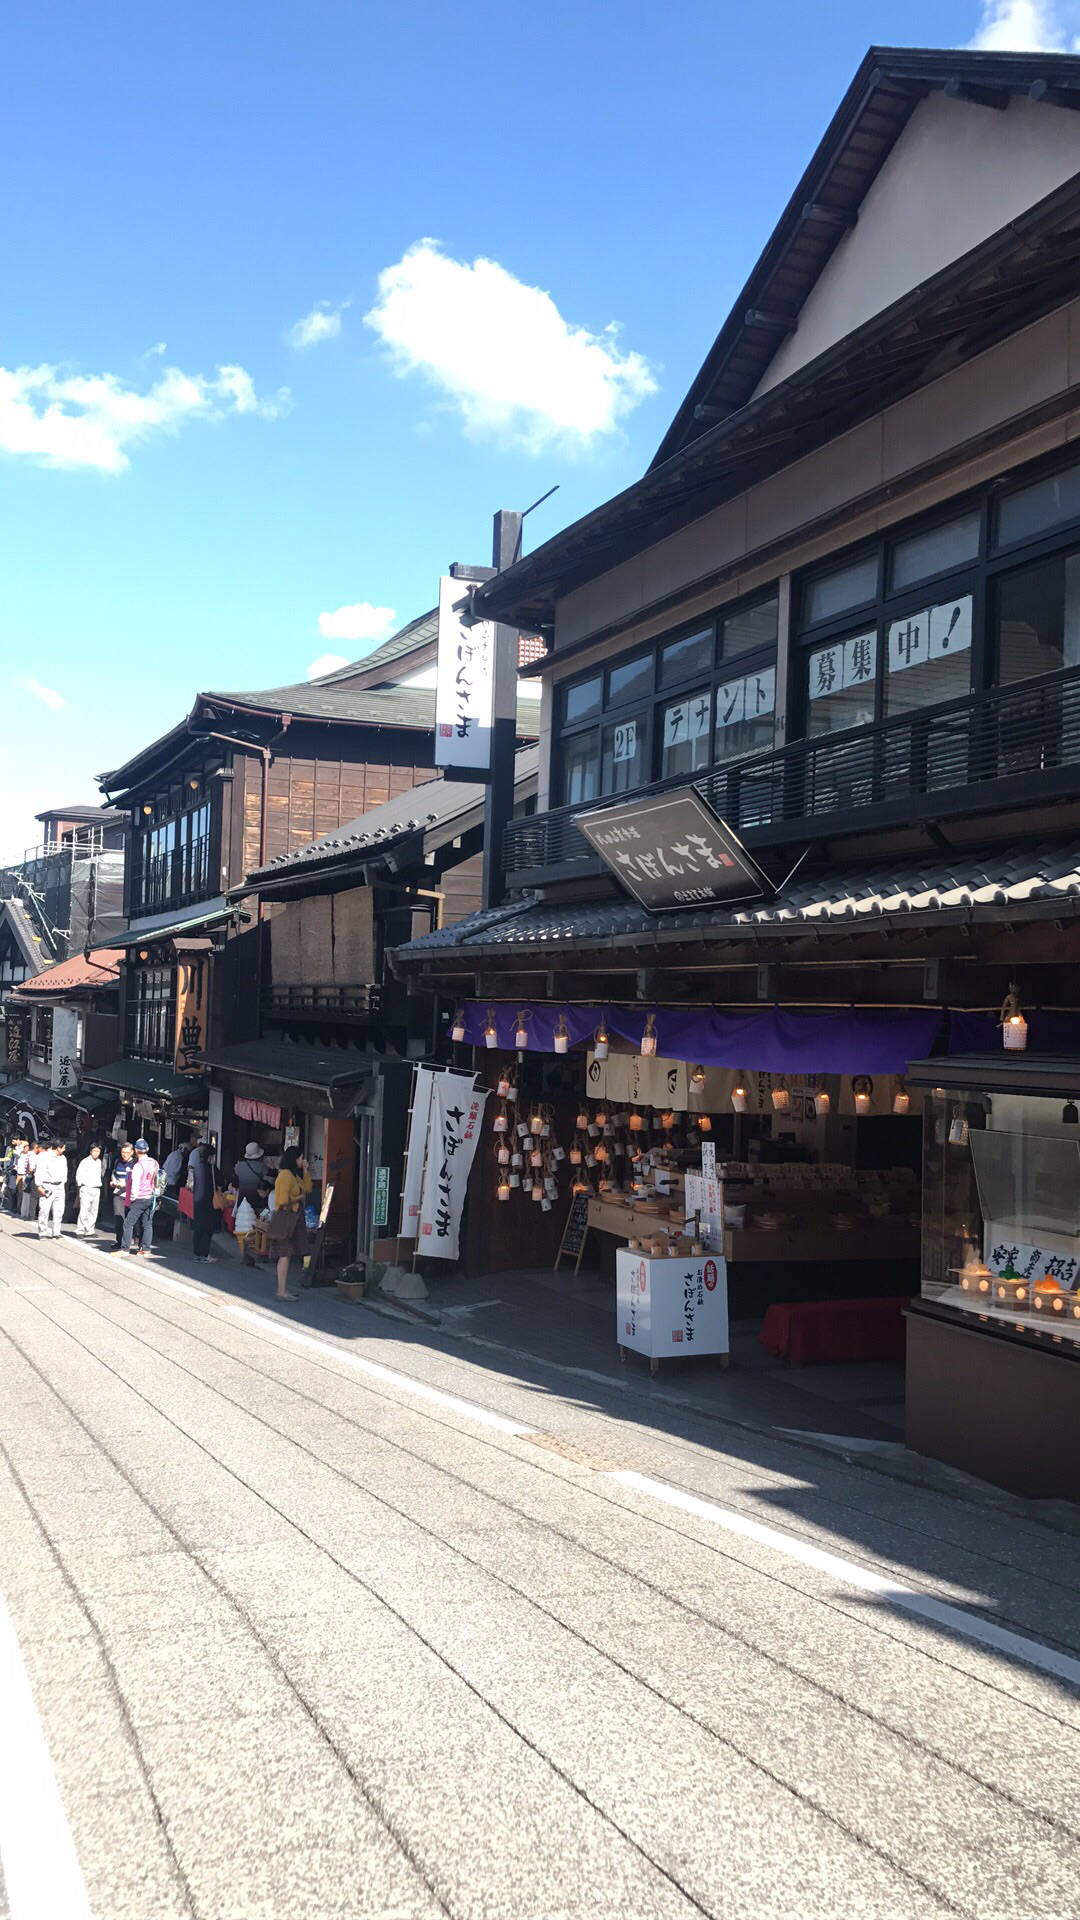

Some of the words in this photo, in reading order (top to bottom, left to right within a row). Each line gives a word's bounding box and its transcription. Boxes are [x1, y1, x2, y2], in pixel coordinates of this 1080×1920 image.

[816, 606, 961, 693] 募集中！
[615, 726, 635, 757] 2F
[669, 677, 767, 742] テナント
[616, 833, 722, 882] さぼんさま
[59, 1056, 71, 1086] 近江屋
[435, 1105, 466, 1238] さぼんさま
[684, 1272, 697, 1341] さぼんさま
